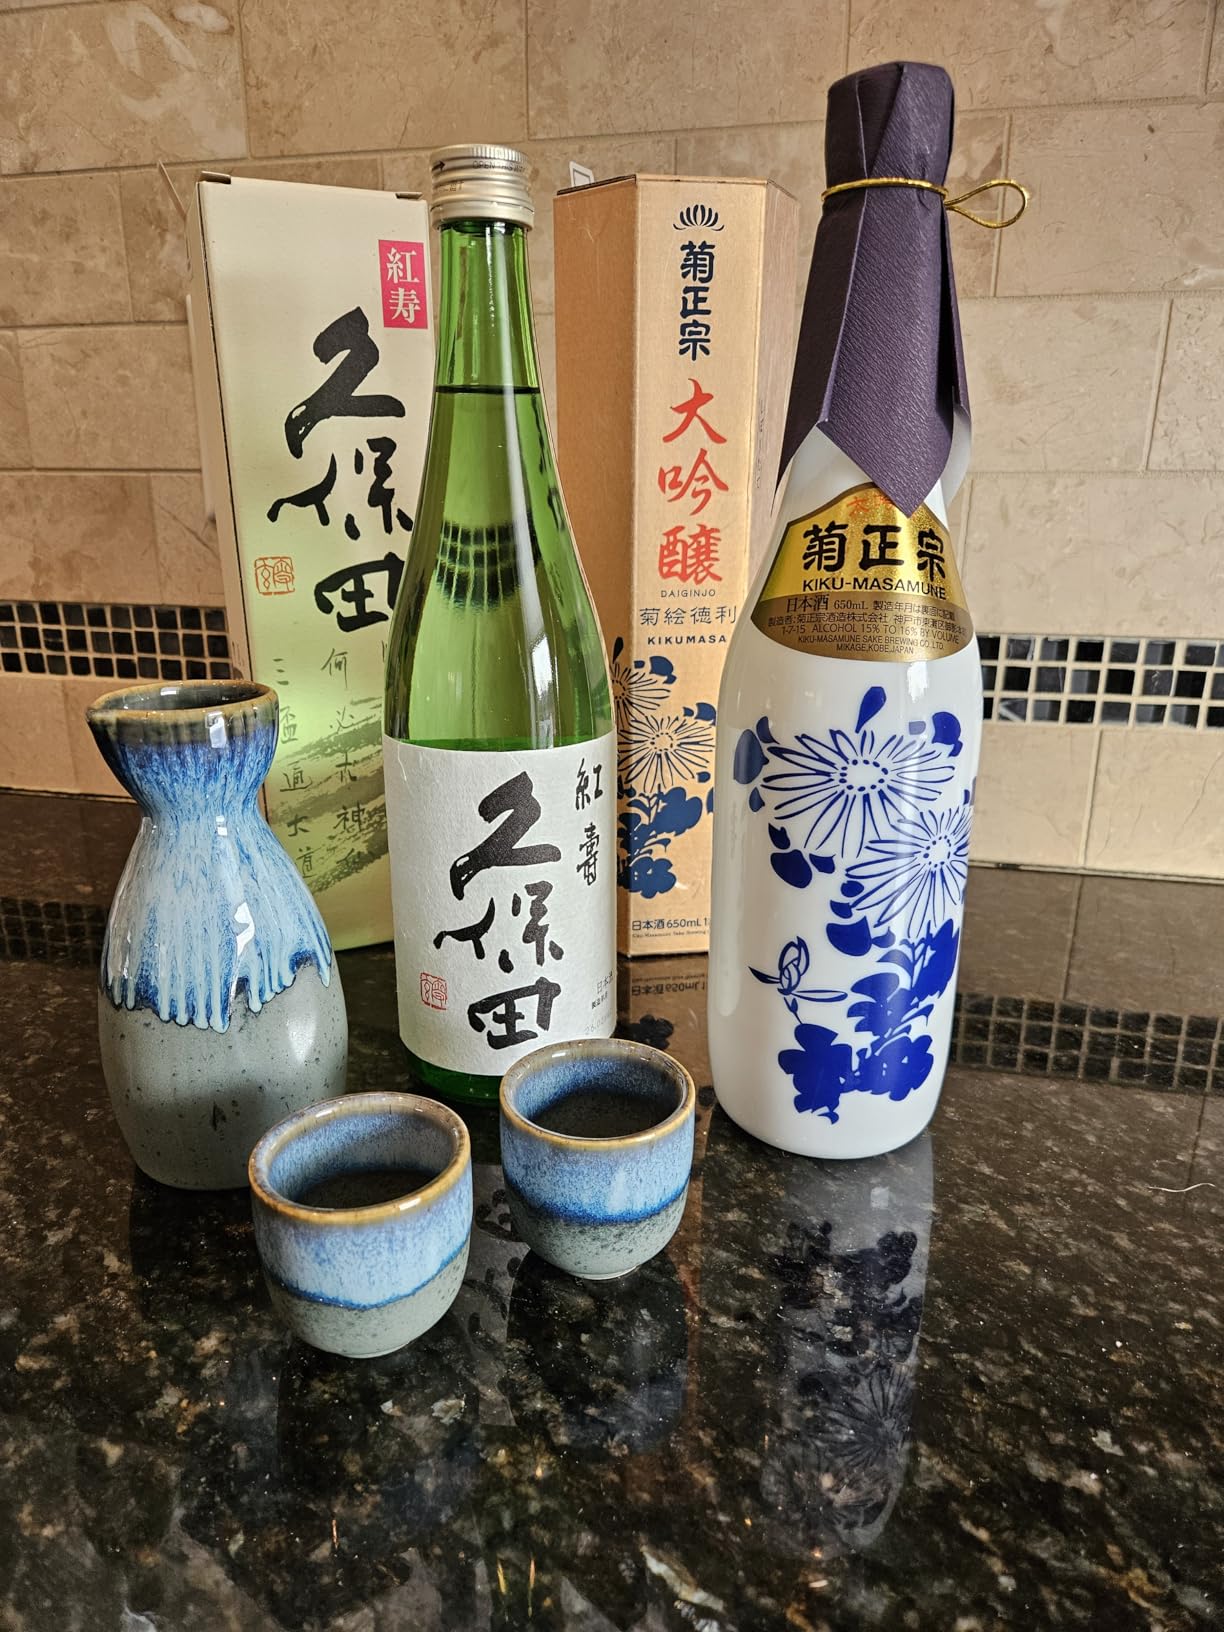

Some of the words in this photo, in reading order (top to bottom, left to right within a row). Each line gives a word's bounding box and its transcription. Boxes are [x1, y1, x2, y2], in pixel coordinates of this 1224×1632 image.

[386, 247, 421, 324] 紅寿
[678, 240, 715, 361] 菊正宗
[267, 306, 413, 632] 久保田
[658, 378, 729, 585] 大吟醸
[803, 521, 945, 581] 菊正宗
[660, 588, 716, 599] DAIGINJO
[803, 578, 946, 600] KIKU-MASAMUNE
[786, 593, 830, 613] 日本酒
[833, 599, 869, 611] 650mL
[639, 605, 737, 627] 菊絵徳利
[647, 635, 727, 646] KIKUMASA
[798, 634, 861, 644] KIKU-MASAMUNE
[862, 635, 884, 644] SAKE
[884, 636, 919, 647] BREWING
[811, 622, 857, 634] ALCOHOL
[861, 624, 881, 634] 15%
[883, 624, 897, 635] TO
[900, 626, 918, 637] 16%
[919, 629, 930, 639] BY
[931, 630, 960, 645] VOLUME
[432, 770, 564, 1050] 久保田
[631, 918, 665, 932] 日本酒
[666, 919, 702, 929] 650mL
